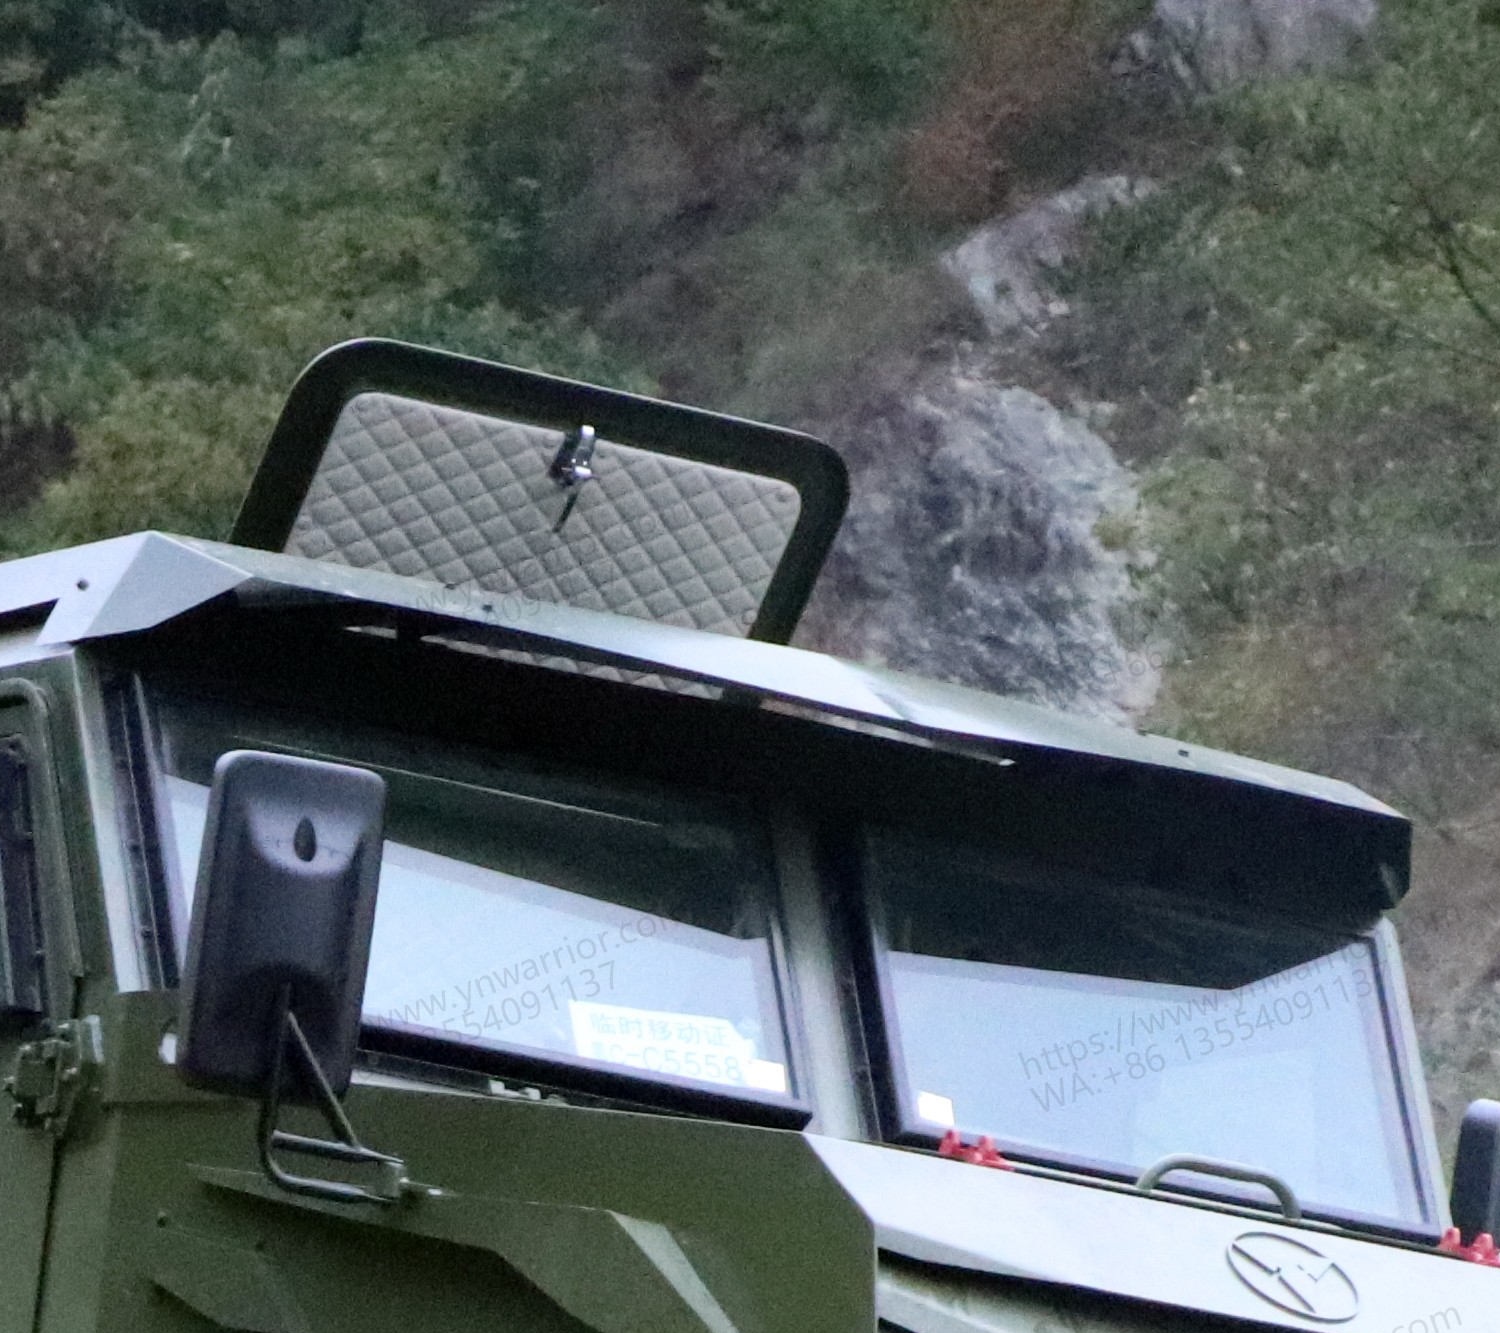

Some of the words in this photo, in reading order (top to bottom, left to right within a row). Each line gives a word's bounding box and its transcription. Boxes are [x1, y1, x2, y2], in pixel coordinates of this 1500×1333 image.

[590, 1011, 729, 1047] 临时移动证
